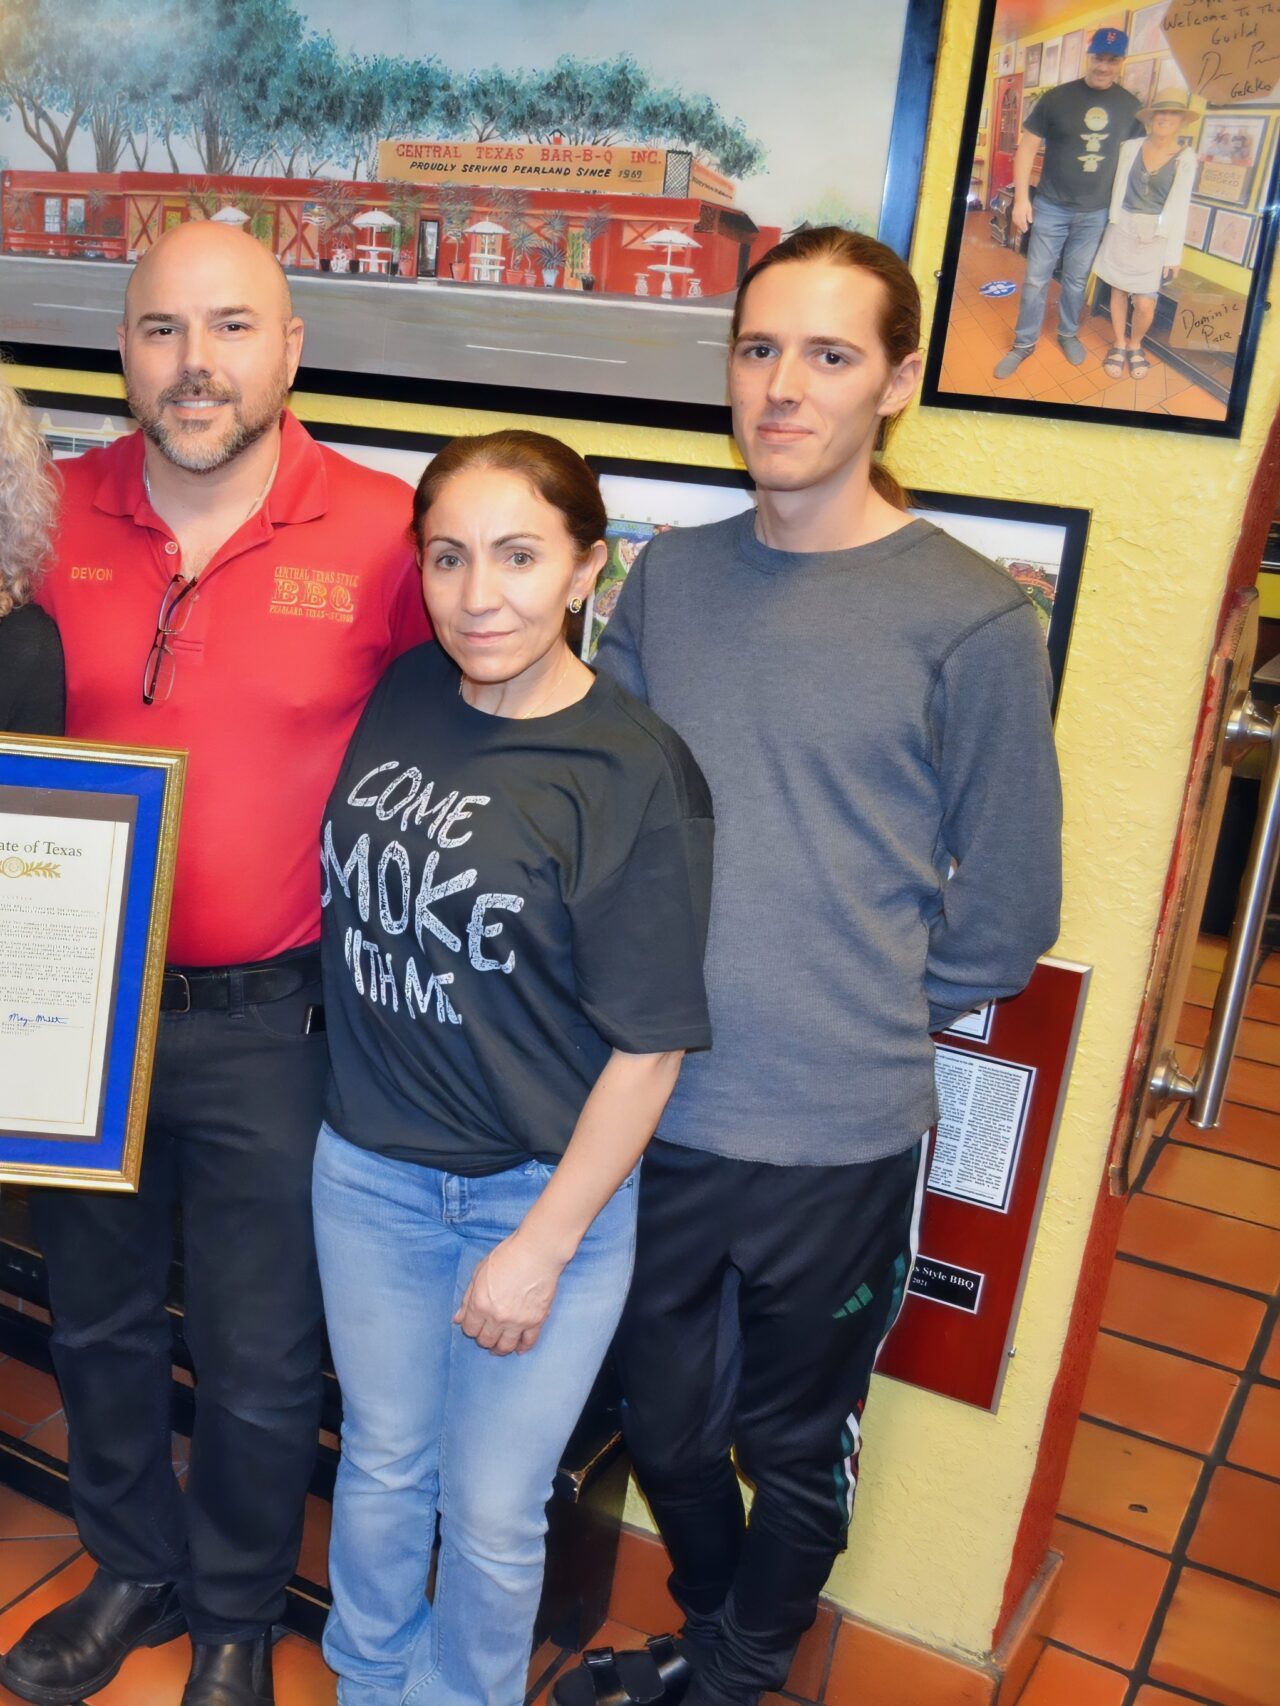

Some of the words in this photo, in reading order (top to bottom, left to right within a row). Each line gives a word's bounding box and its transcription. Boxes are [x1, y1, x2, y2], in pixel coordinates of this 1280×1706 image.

[1163, 10, 1227, 31] Welcome
[1211, 22, 1258, 45] Guild
[396, 143, 462, 159] CENTRAL
[475, 146, 525, 161] TEXAS
[540, 148, 613, 165] BAR-B-Q
[631, 150, 662, 165] INC.
[409, 160, 457, 172] PROUDLY
[513, 165, 571, 177] PEARLAND
[576, 167, 612, 178] SINCE
[71, 566, 113, 581] DEVON
[274, 566, 310, 580] CENTRAL
[271, 578, 354, 613] BBQ
[347, 761, 491, 849] COME
[23, 840, 40, 854] of
[42, 841, 82, 857] Texas
[320, 820, 524, 974] MOKE
[922, 1266, 948, 1281] Style
[949, 1274, 975, 1291] BBQ
